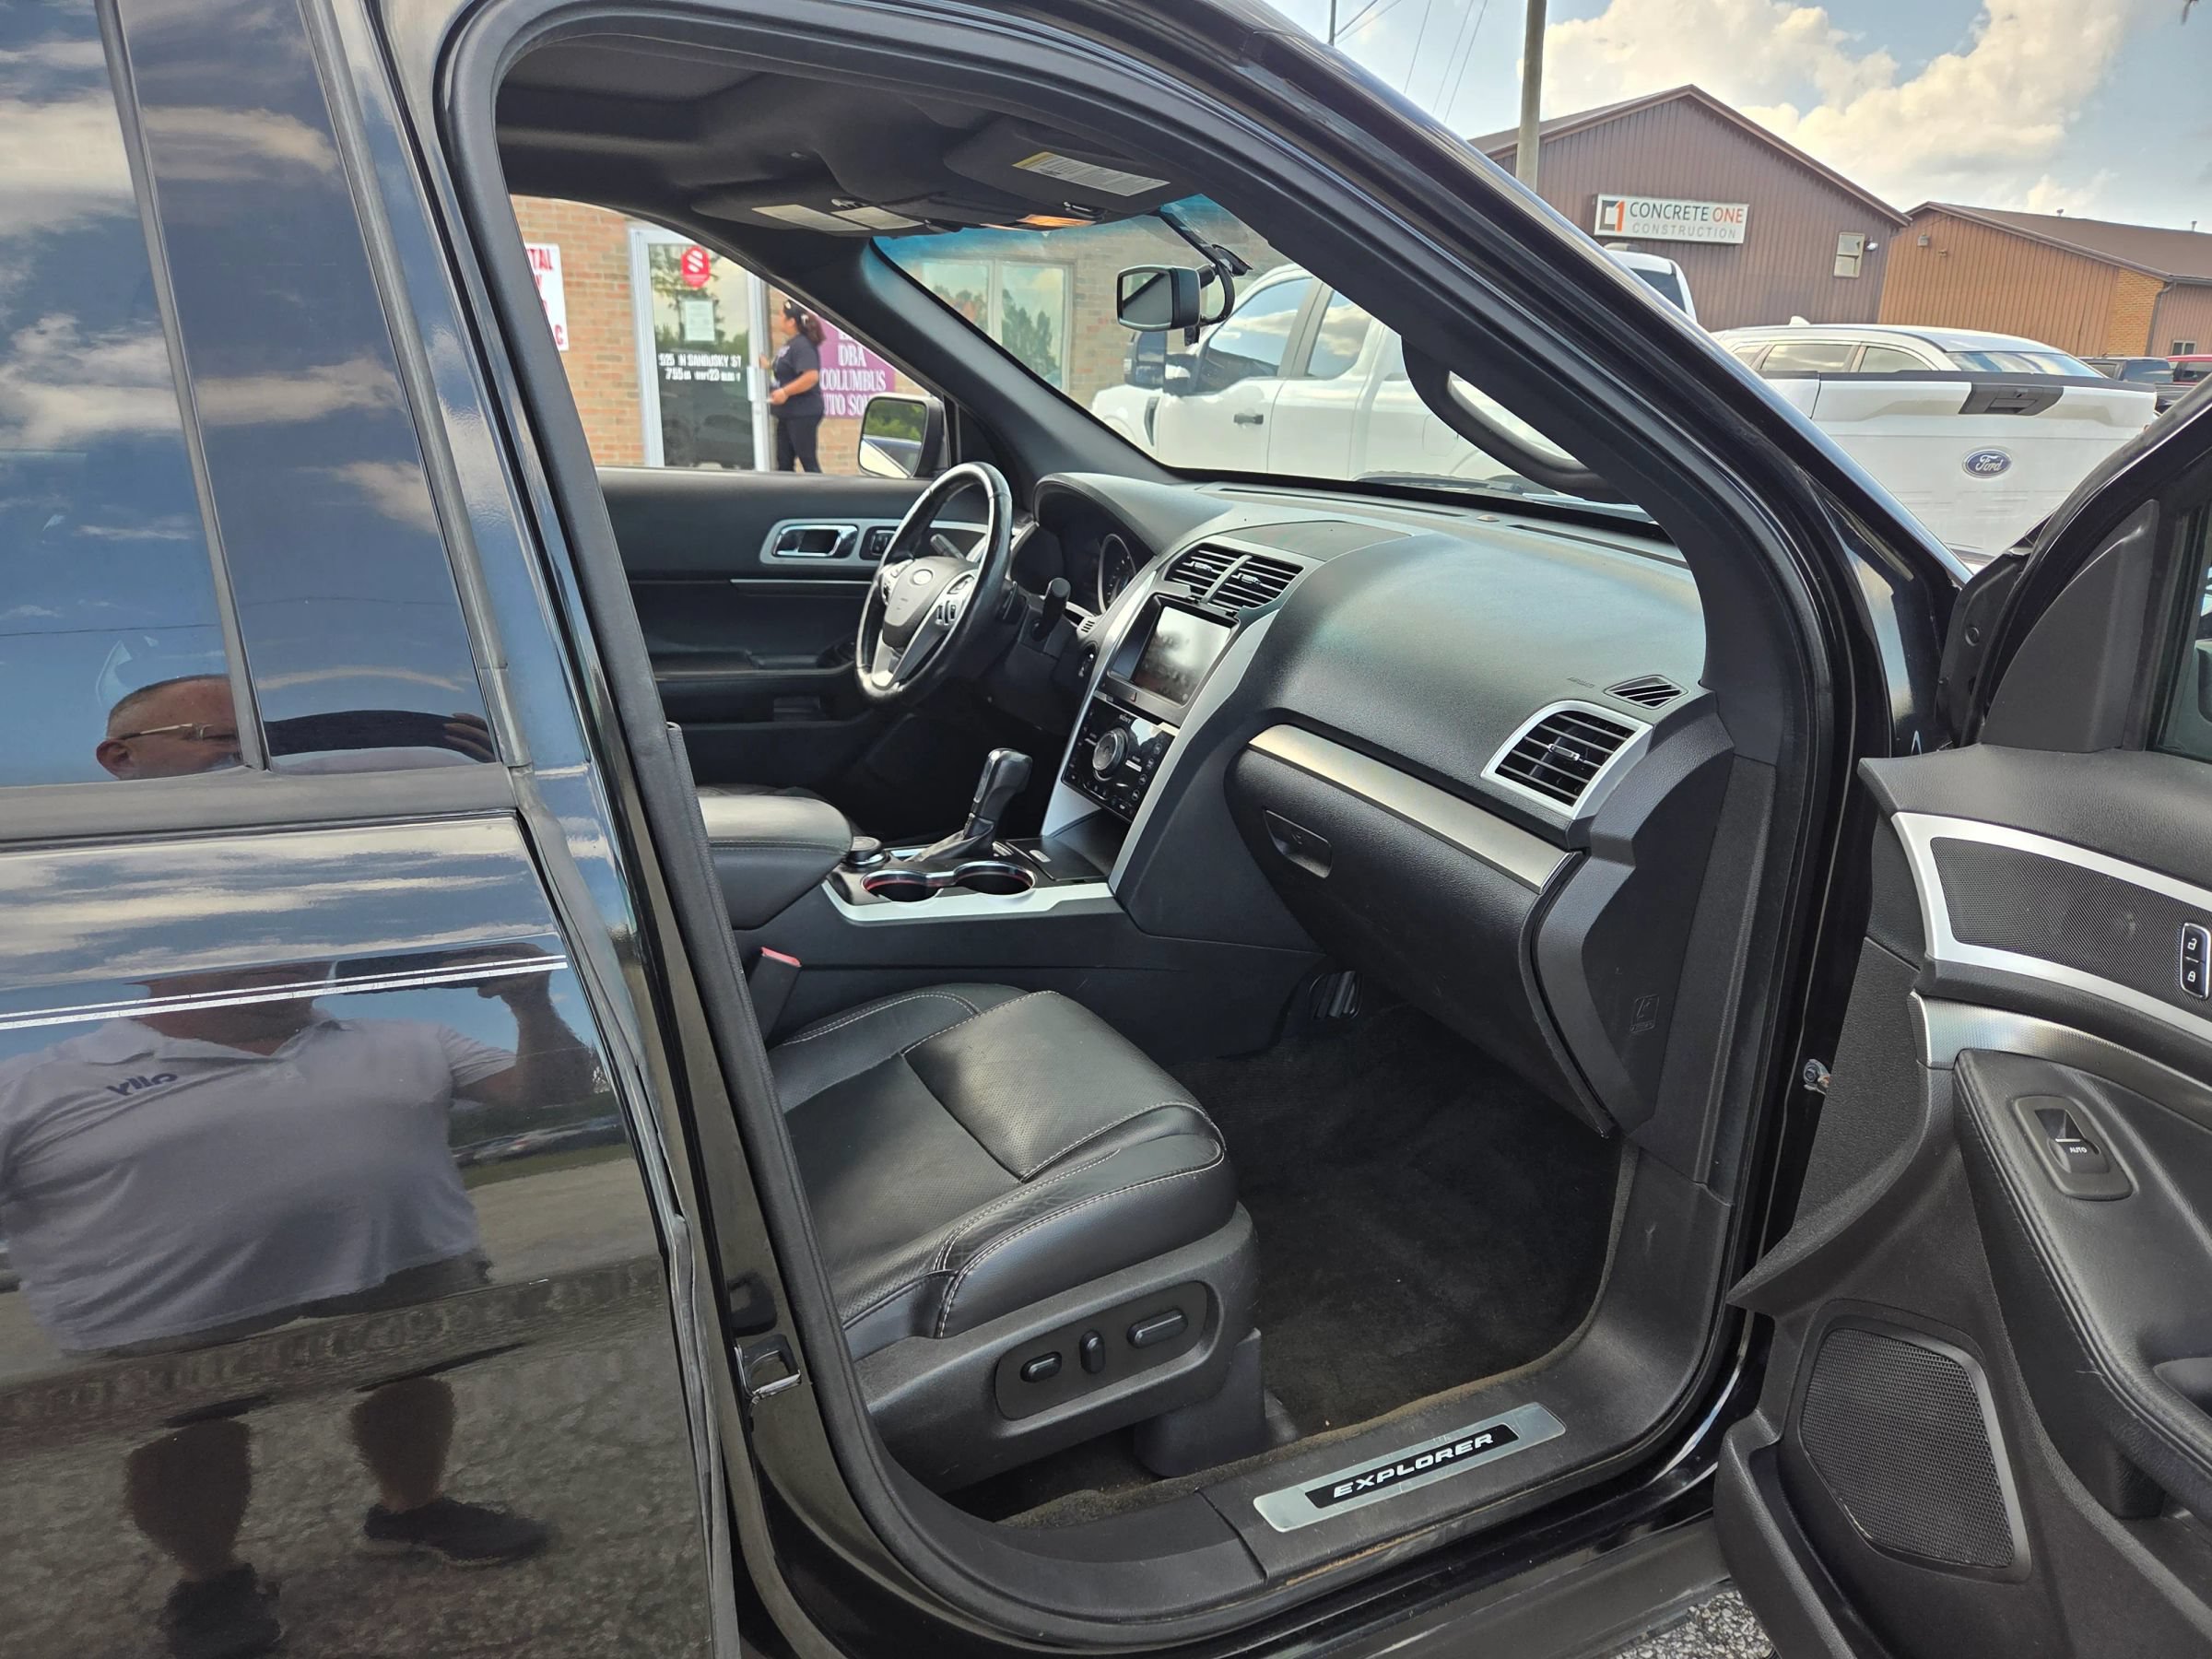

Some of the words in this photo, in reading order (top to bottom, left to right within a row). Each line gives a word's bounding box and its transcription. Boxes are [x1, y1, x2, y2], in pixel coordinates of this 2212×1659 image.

[1630, 201, 1709, 221] CONCRETE
[1712, 206, 1743, 224] ONE
[1632, 222, 1735, 239] CONSTRUCTION
[687, 353, 729, 368] SANDUSKY
[837, 345, 867, 367] DBA
[819, 368, 887, 392] COLUMBUS
[1975, 454, 2004, 472] Ford
[1333, 1432, 1494, 1498] EXPLORER
